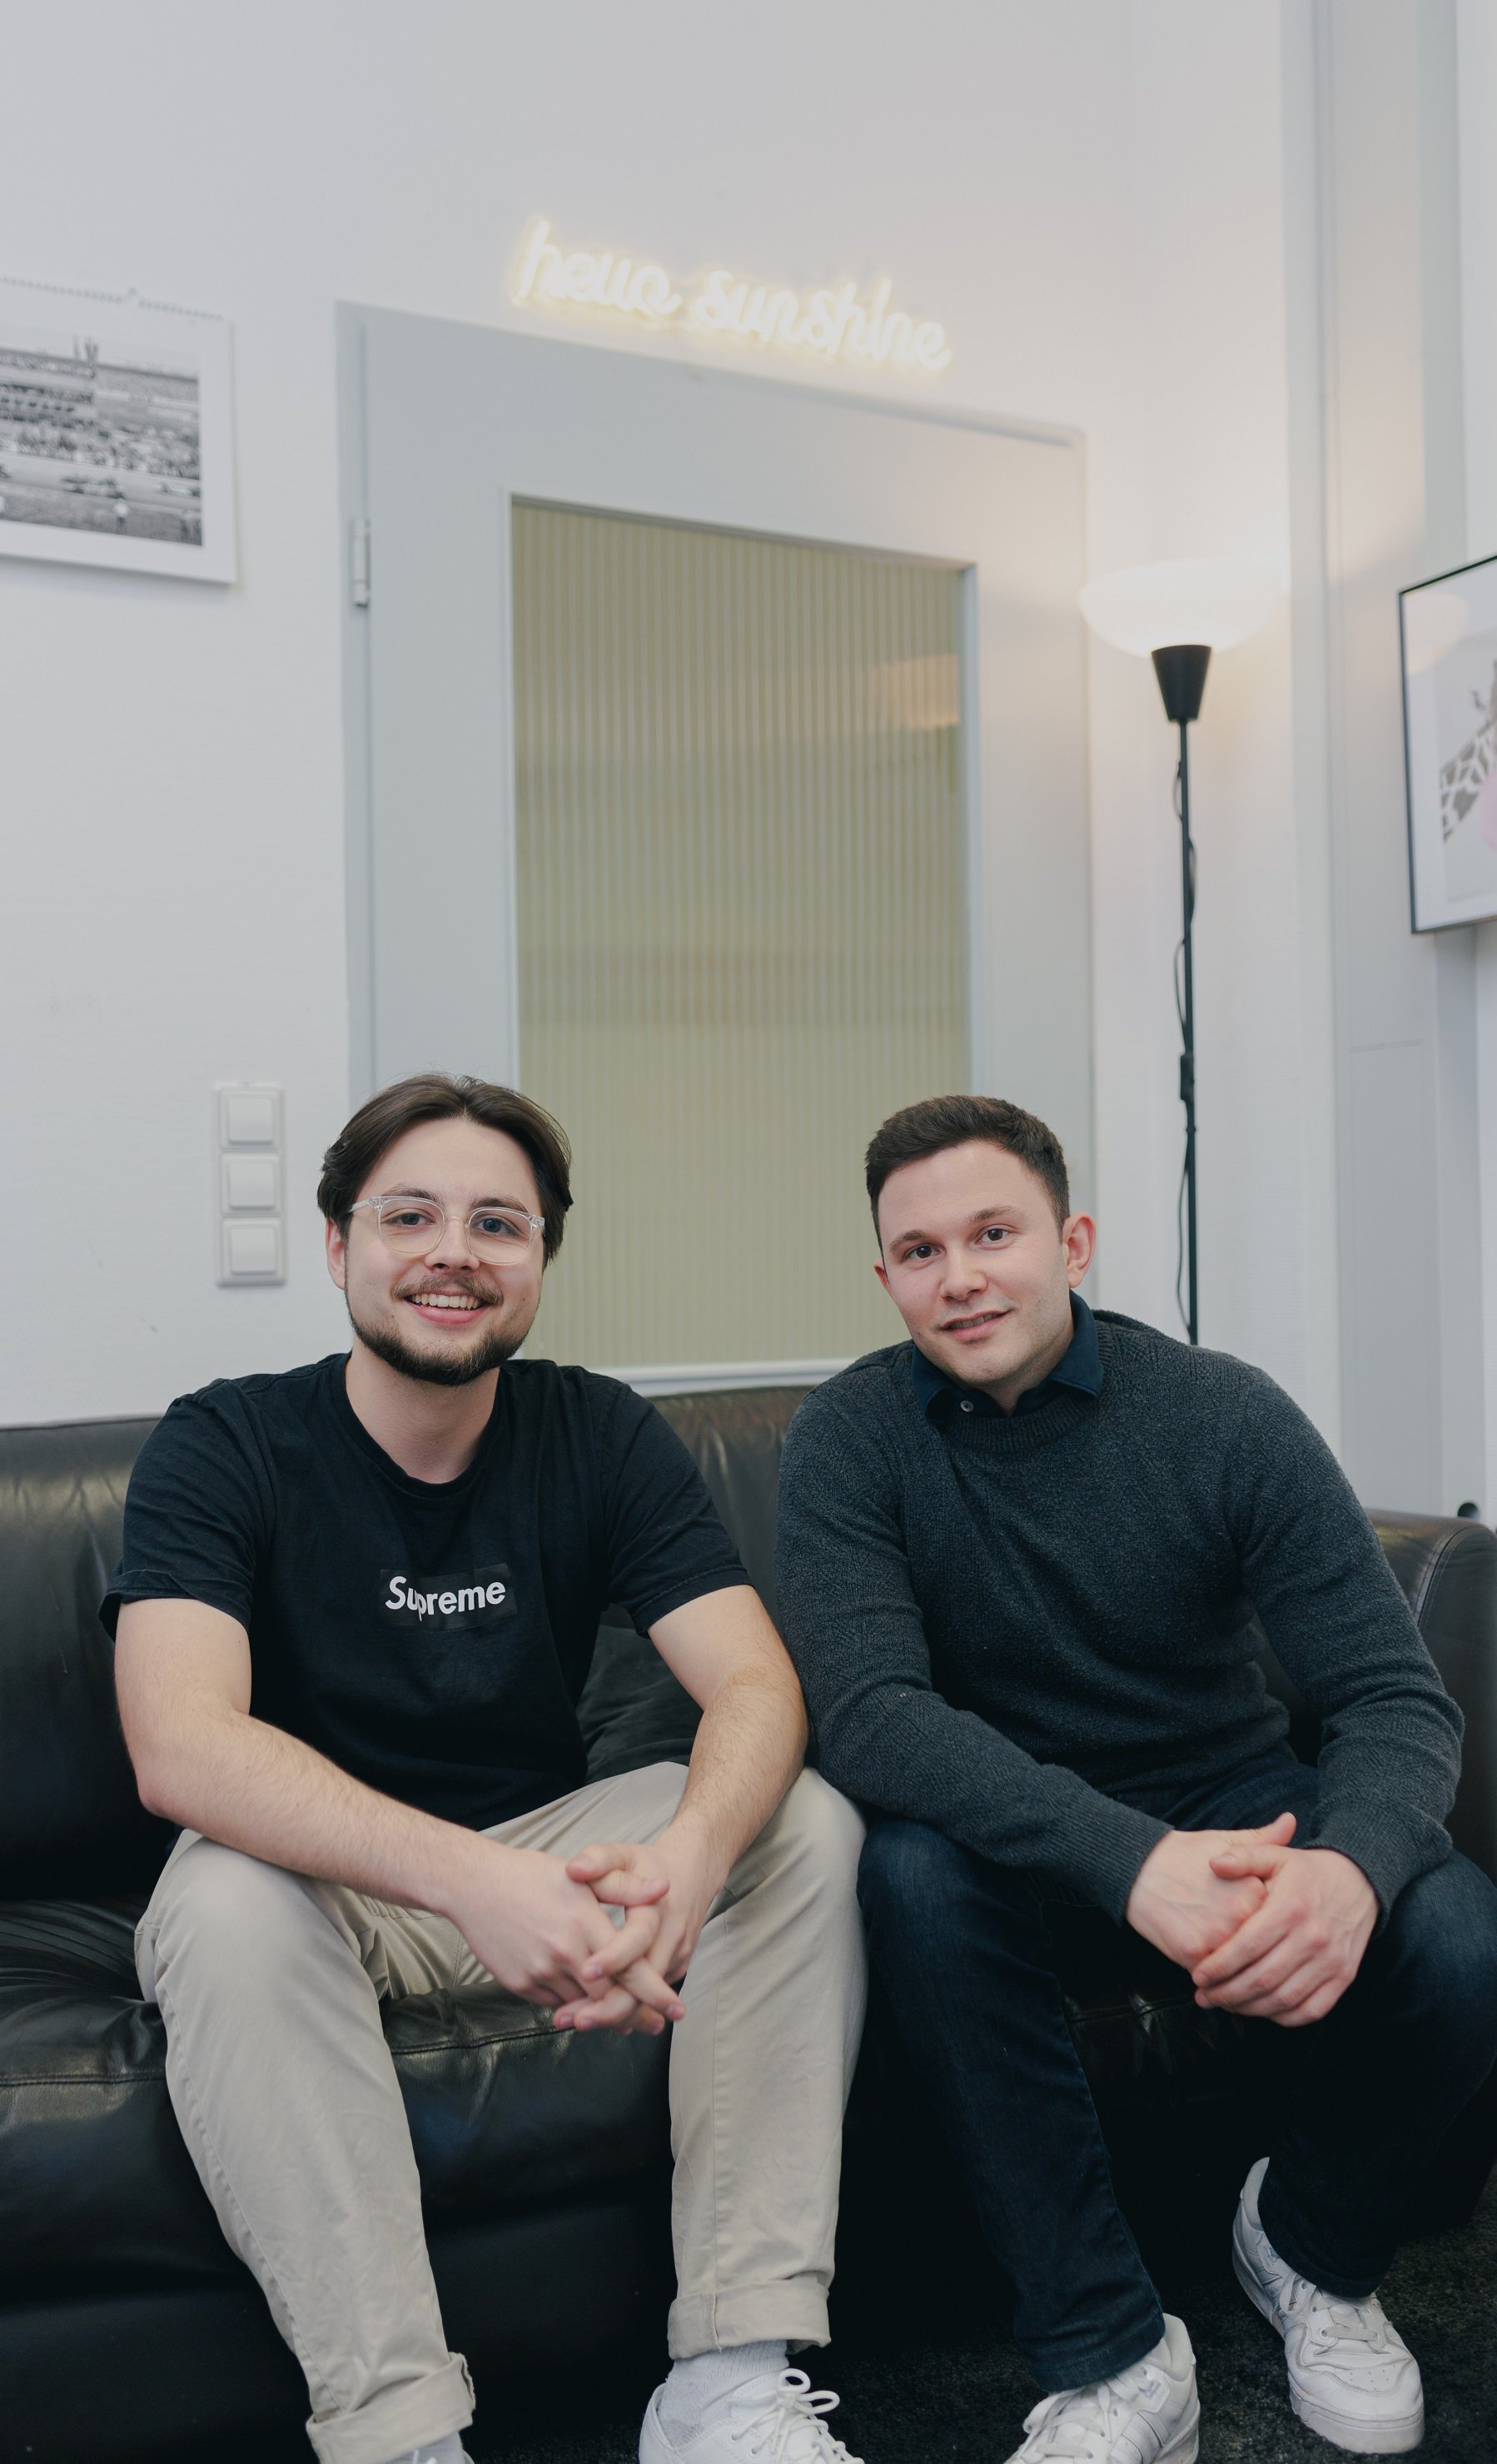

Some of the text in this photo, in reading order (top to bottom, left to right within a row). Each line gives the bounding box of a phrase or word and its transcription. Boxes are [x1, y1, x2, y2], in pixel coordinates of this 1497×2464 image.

[513, 219, 952, 369] hello sunshine
[385, 1575, 506, 1622] Supreme
